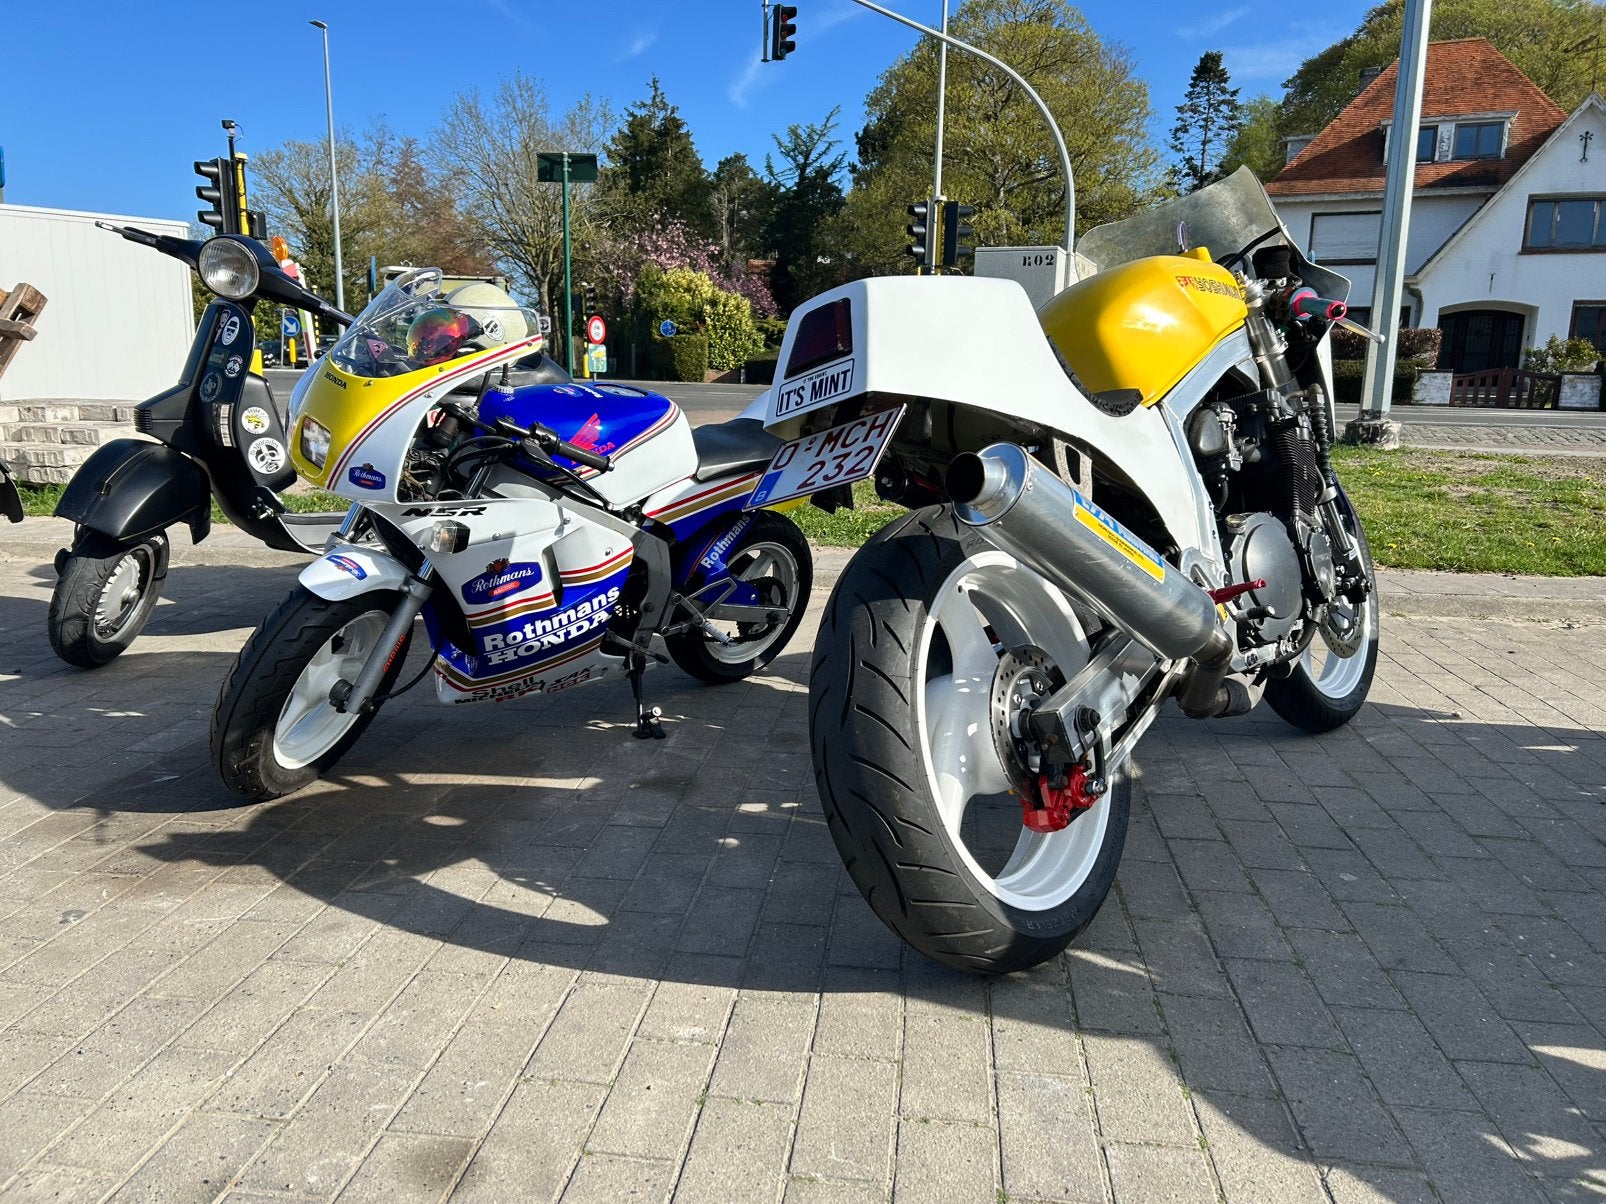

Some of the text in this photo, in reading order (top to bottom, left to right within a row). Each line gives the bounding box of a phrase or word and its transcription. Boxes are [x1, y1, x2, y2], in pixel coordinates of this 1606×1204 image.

[324, 371, 347, 390] HONDA
[779, 368, 851, 413] IT'S MINT
[797, 445, 875, 491] 232
[400, 506, 487, 517] NSR
[757, 490, 767, 501] B
[700, 514, 750, 569] Rothmans
[471, 567, 535, 594] Rothmans
[483, 586, 620, 651] Rothmans
[488, 610, 612, 666] HONDA
[472, 676, 534, 697] Shell
